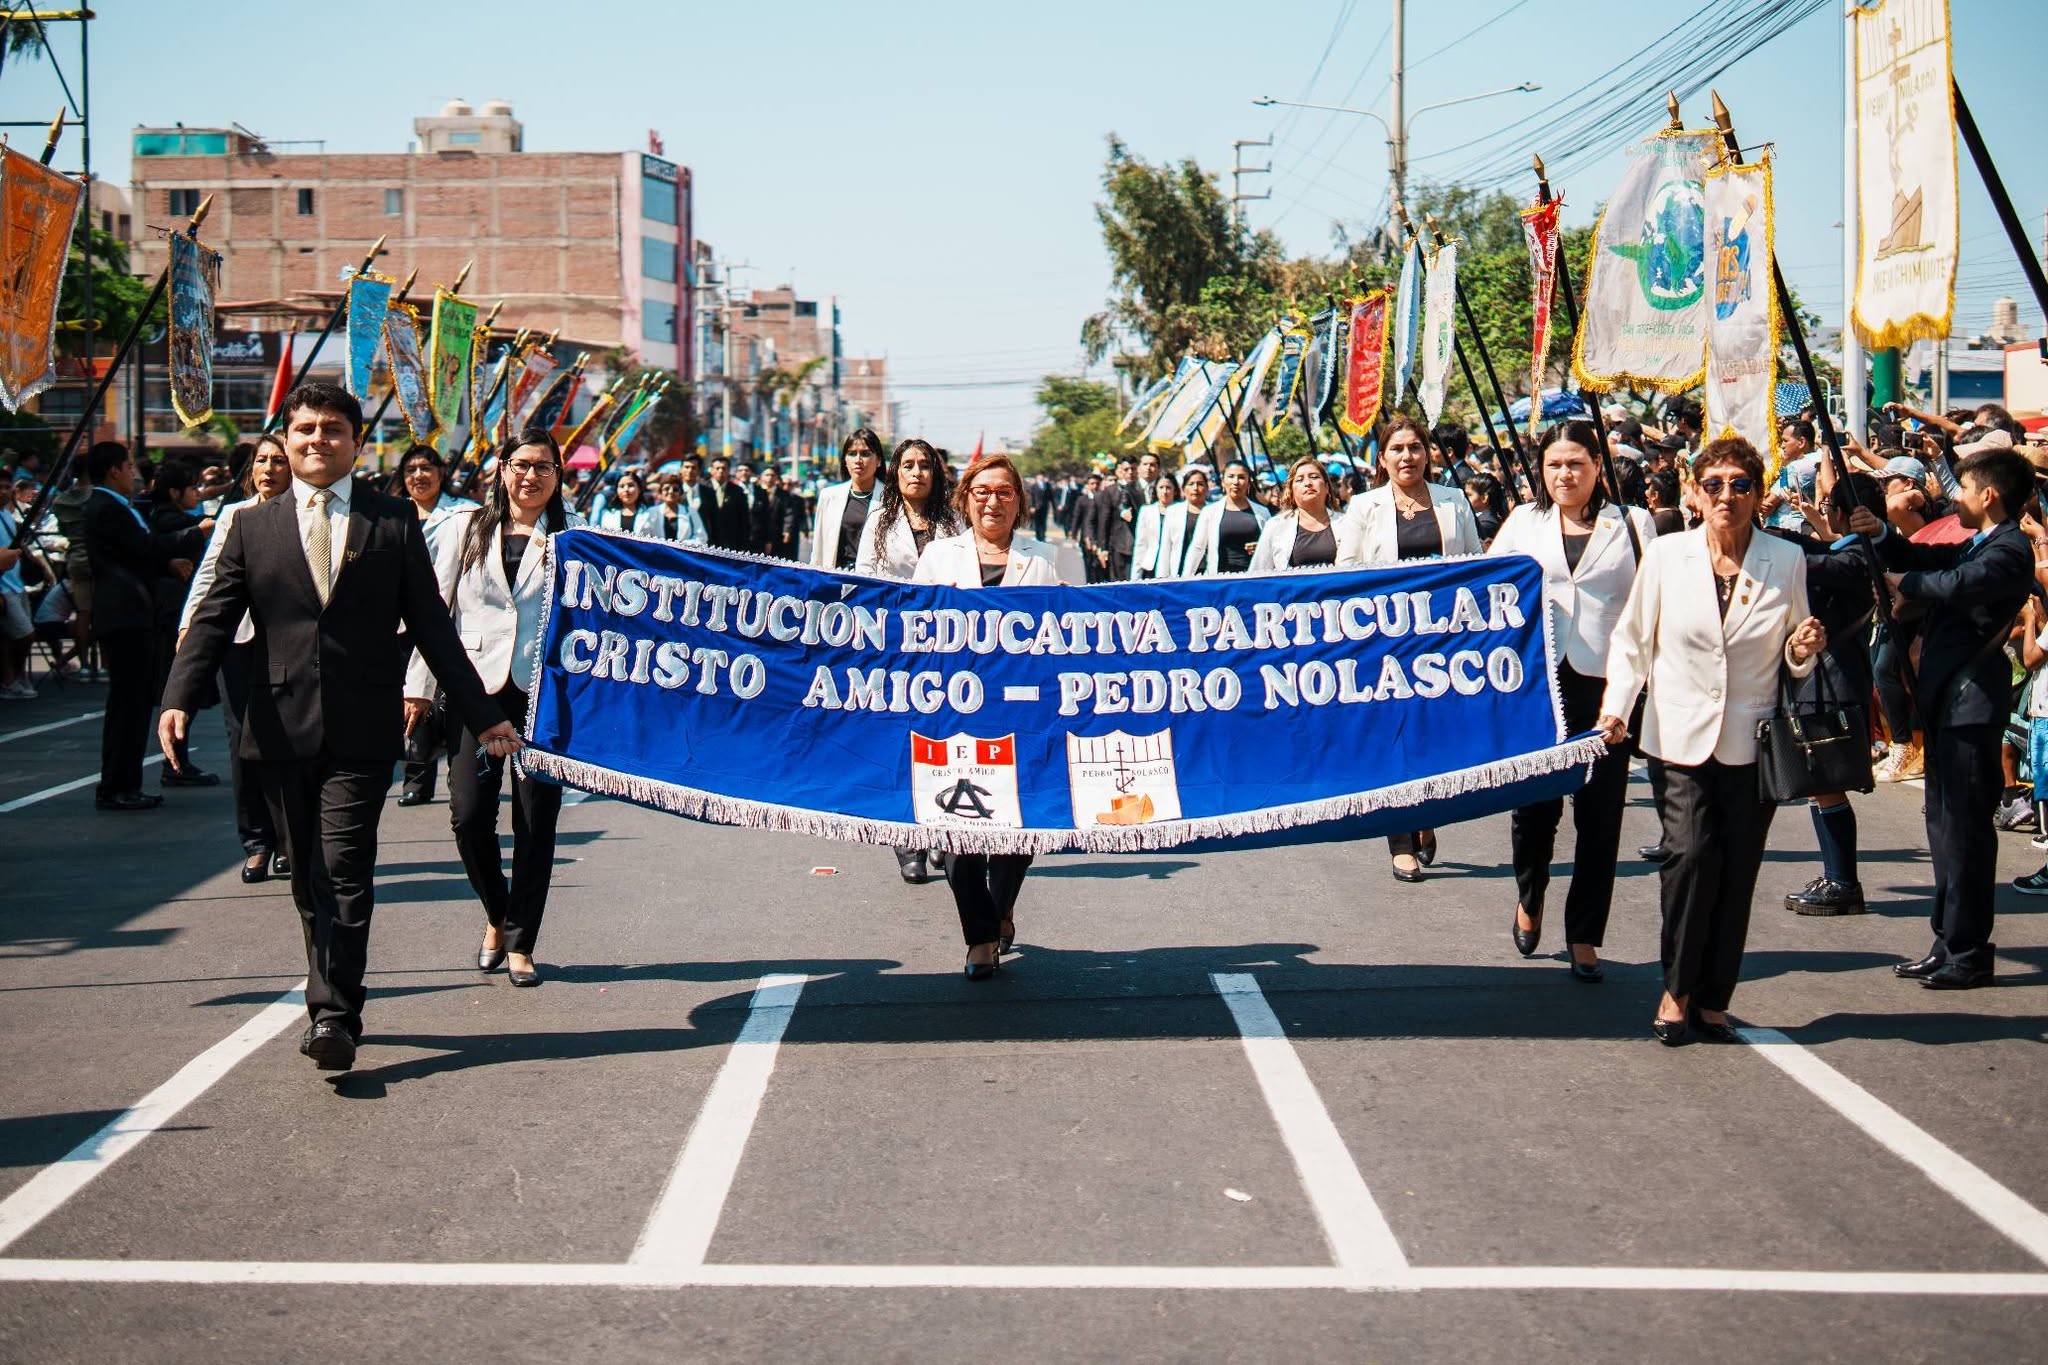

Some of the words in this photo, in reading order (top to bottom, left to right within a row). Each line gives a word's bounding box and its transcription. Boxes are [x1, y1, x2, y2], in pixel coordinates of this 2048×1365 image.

[560, 559, 887, 652] INSTITUCIÓN
[901, 608, 1176, 655] EDUCATIVA
[1186, 583, 1526, 653] PARTICULAR
[560, 629, 766, 700] CRISTO
[802, 665, 985, 713] AMIGO
[1058, 667, 1242, 716] PEDRO
[1260, 647, 1525, 710] NOLASCO
[926, 744, 934, 760] I
[956, 745, 968, 759] E
[988, 744, 1001, 760] P
[1082, 769, 1113, 777] PEDRO
[1131, 767, 1169, 777] NOLASCO
